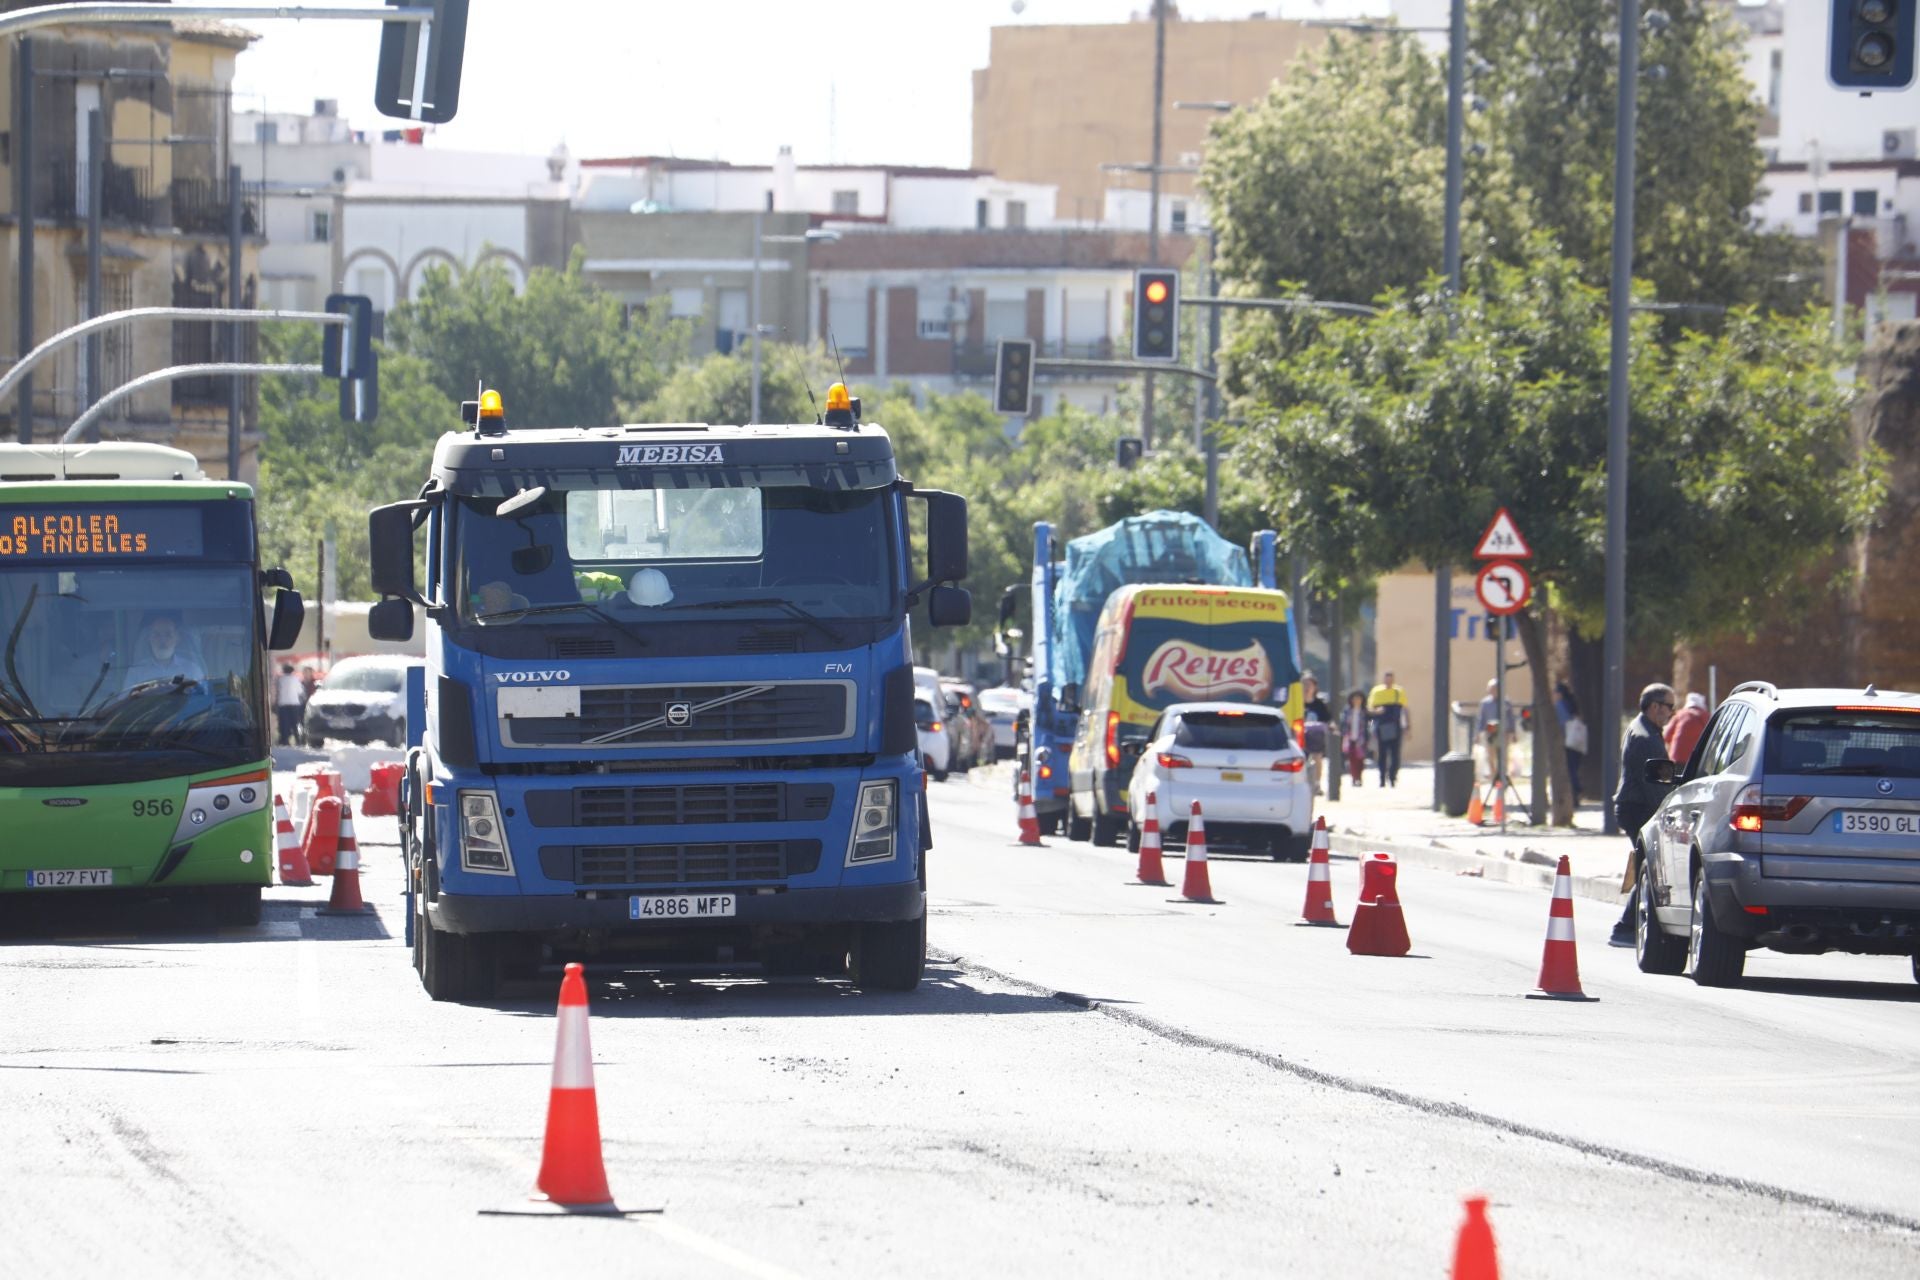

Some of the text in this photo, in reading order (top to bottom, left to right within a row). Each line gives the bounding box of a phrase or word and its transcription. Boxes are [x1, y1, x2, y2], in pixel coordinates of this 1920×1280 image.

[616, 444, 724, 466] MEBISA
[13, 514, 119, 535] ALCOLEA
[0, 533, 147, 555] OS ANGELES
[1141, 595, 1277, 611] frutos secos
[493, 669, 571, 683] VOLVO
[824, 663, 853, 673] FM
[1147, 646, 1265, 688] Reyes
[132, 798, 174, 817] 956
[1846, 815, 1920, 833] 3590 GL
[36, 870, 108, 886] 0127 FVT
[642, 897, 732, 916] 4886 MFP
